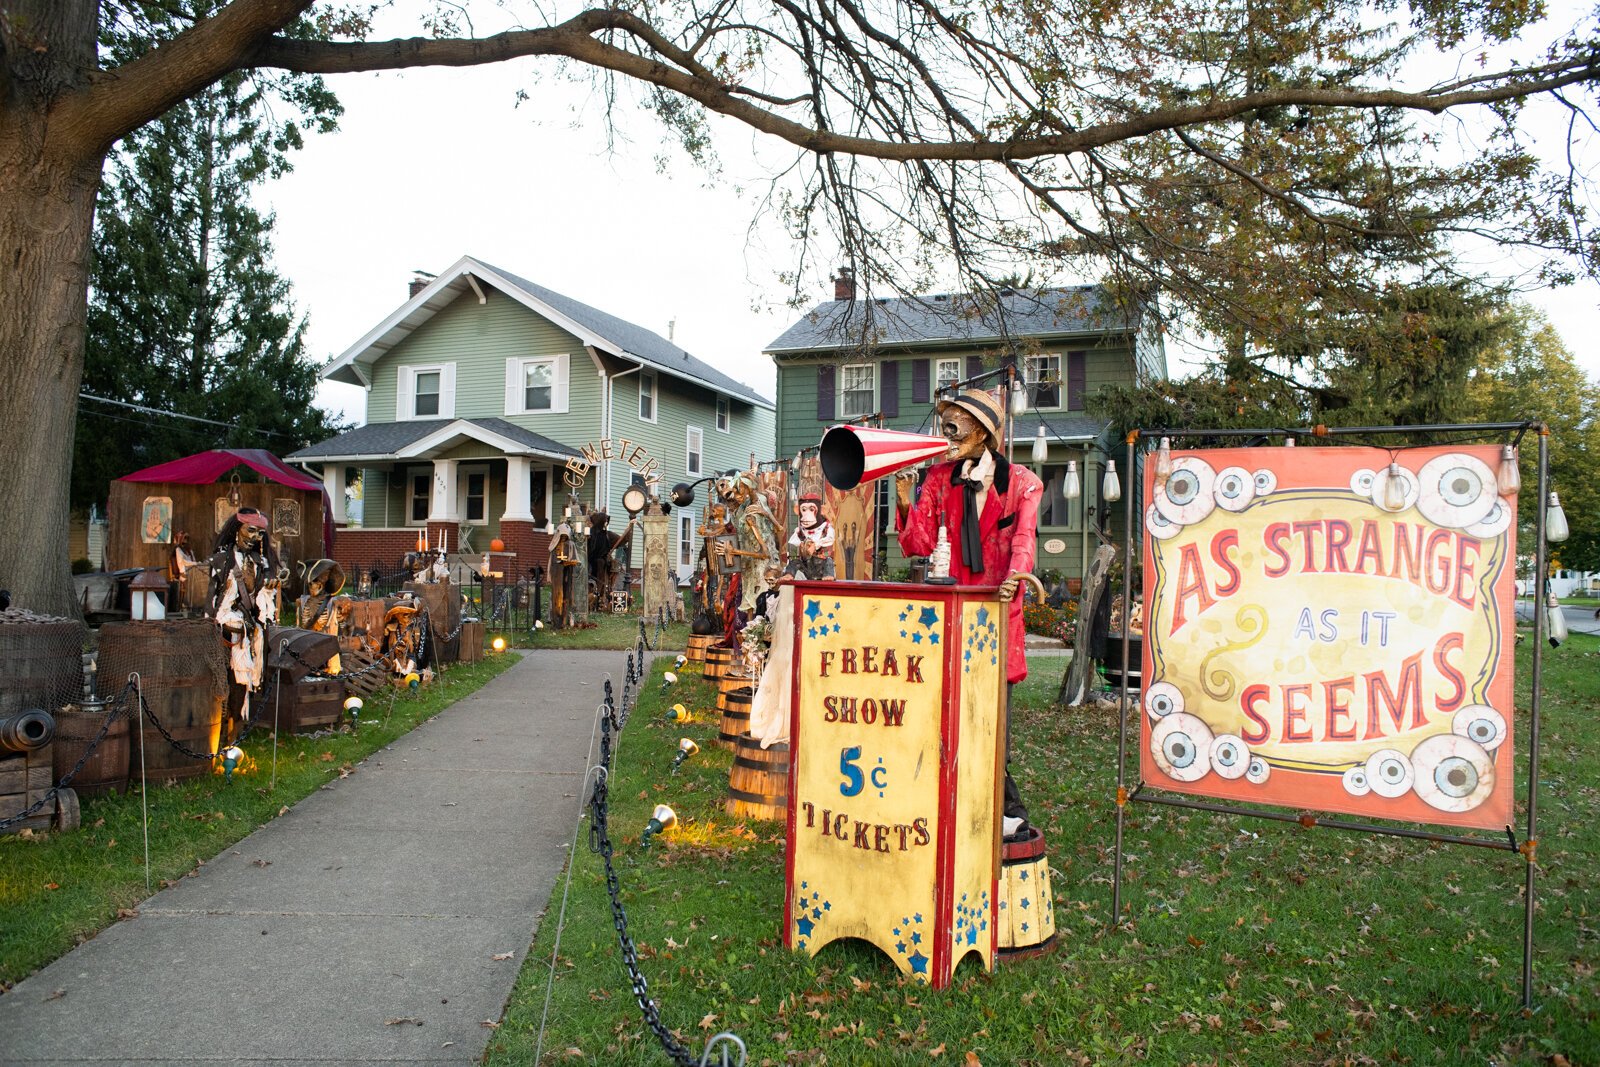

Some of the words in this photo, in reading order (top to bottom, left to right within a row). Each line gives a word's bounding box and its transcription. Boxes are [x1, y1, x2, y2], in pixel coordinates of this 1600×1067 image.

[563, 438, 668, 488] CEMETERY
[1169, 528, 1242, 638] AS
[1263, 519, 1482, 611] STRANGE
[1294, 607, 1339, 643] AS
[1360, 611, 1397, 647] IT
[820, 646, 925, 684] FREAK
[1240, 632, 1466, 746] SEEMS
[824, 695, 908, 727] SHOW
[802, 801, 931, 854] TICKETS
